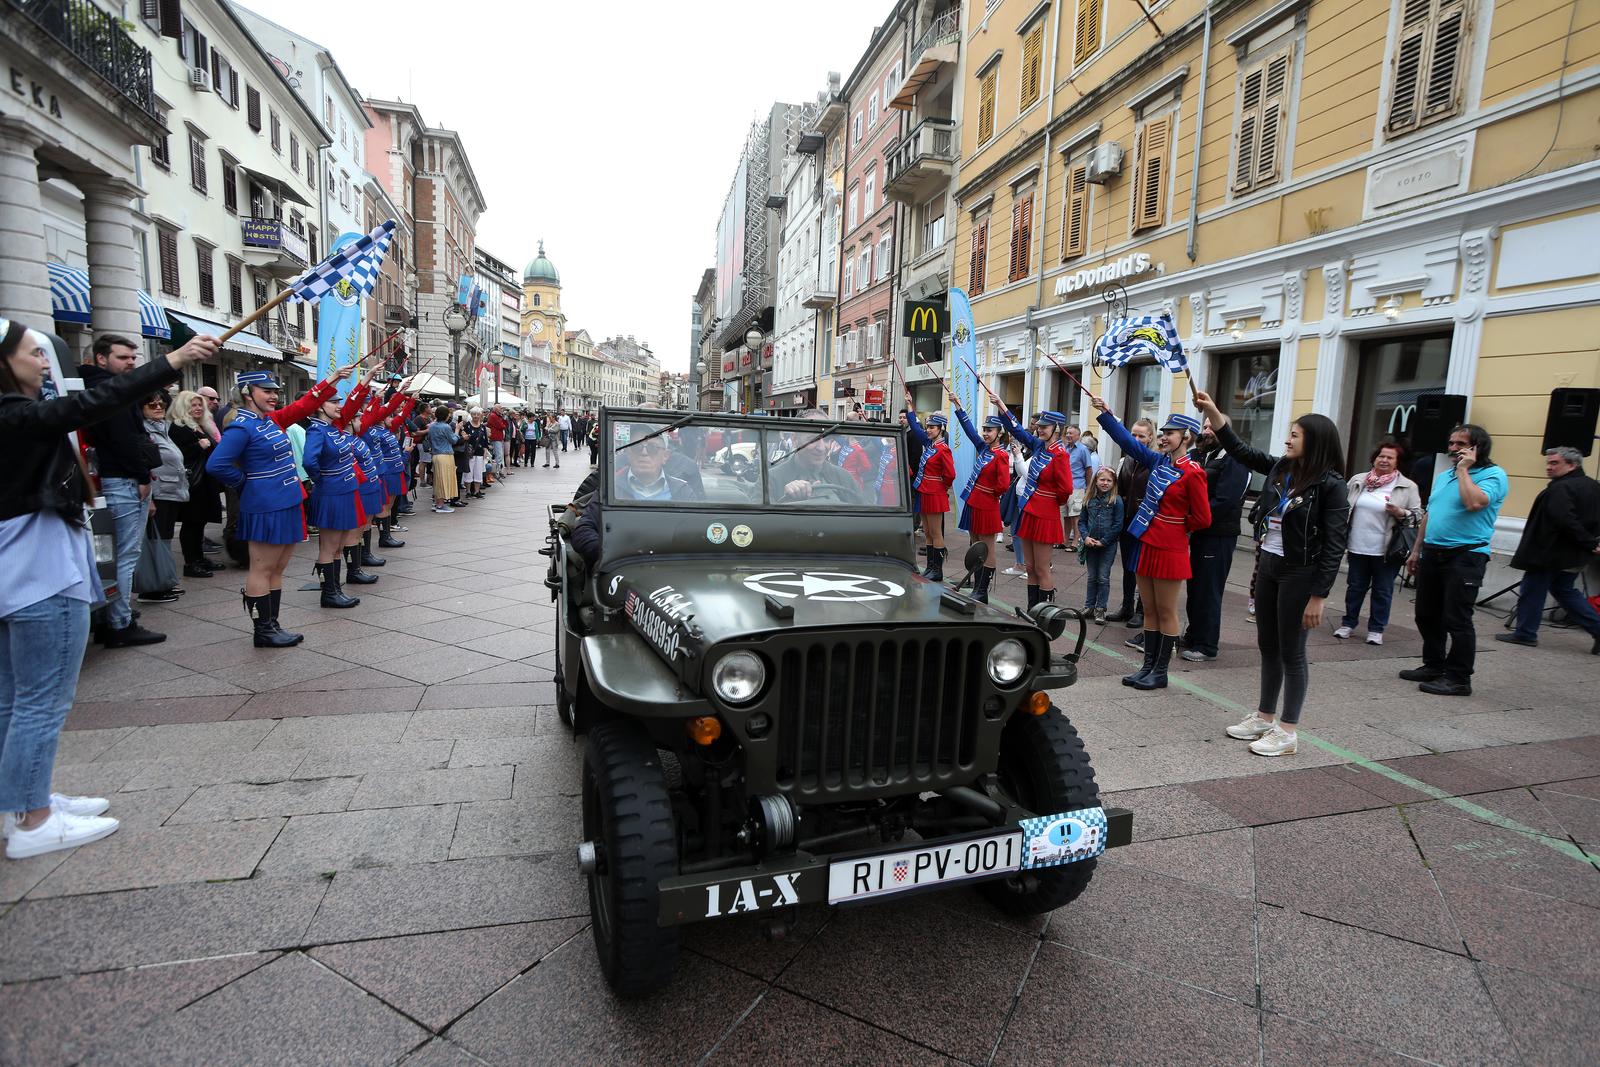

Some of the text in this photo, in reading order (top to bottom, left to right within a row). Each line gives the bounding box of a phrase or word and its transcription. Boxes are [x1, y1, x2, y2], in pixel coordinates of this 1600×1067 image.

[246, 231, 280, 241] HOSTEL
[247, 223, 278, 233] HAPPY
[1054, 252, 1152, 296] McDonald's
[607, 574, 625, 596] S
[852, 837, 1013, 894] RI PV-001
